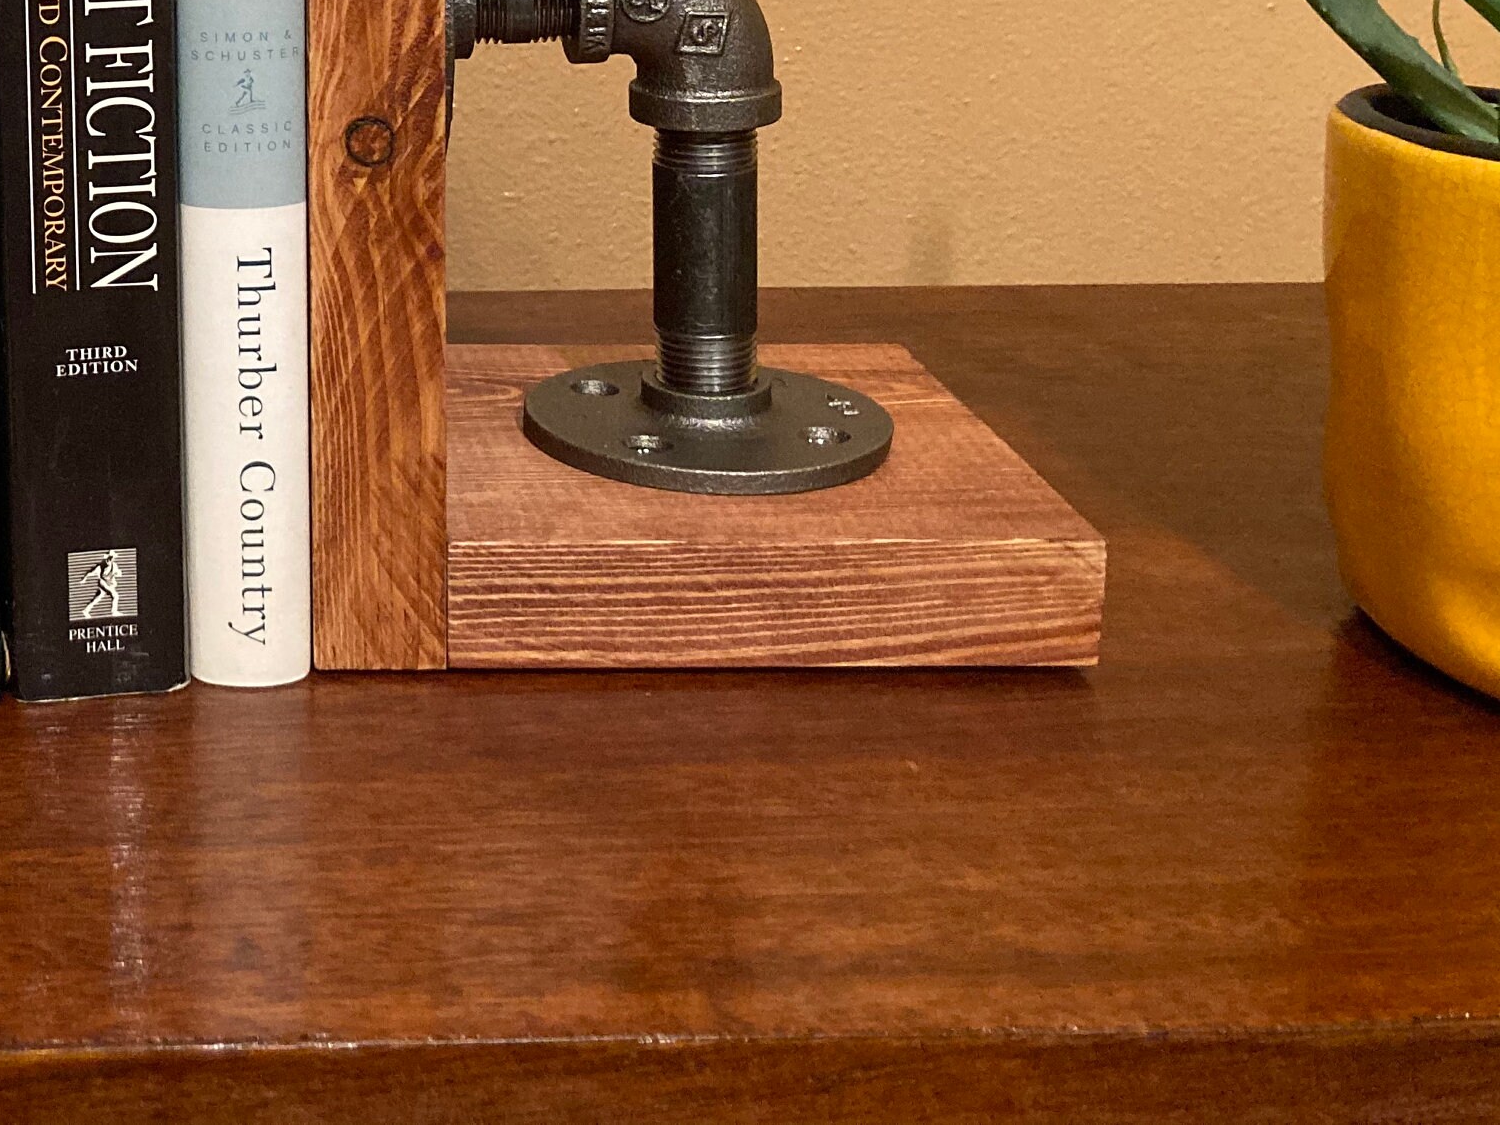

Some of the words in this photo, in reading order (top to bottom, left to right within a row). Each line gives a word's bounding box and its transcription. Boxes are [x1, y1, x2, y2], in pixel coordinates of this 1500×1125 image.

[200, 31, 269, 43] SIMON
[283, 29, 292, 40] &
[190, 46, 300, 62] SCHUSTER
[201, 121, 292, 135] CLASSIC
[203, 138, 292, 153] EDITION
[38, 35, 68, 292] CONTEMPORARY
[85, 39, 159, 292] FICTION
[235, 246, 278, 441] Thurber
[66, 345, 128, 362] THIRD
[56, 359, 139, 377] EDITION
[228, 460, 277, 645] Country
[69, 623, 139, 642] PRENTICE
[86, 638, 126, 654] HALL
